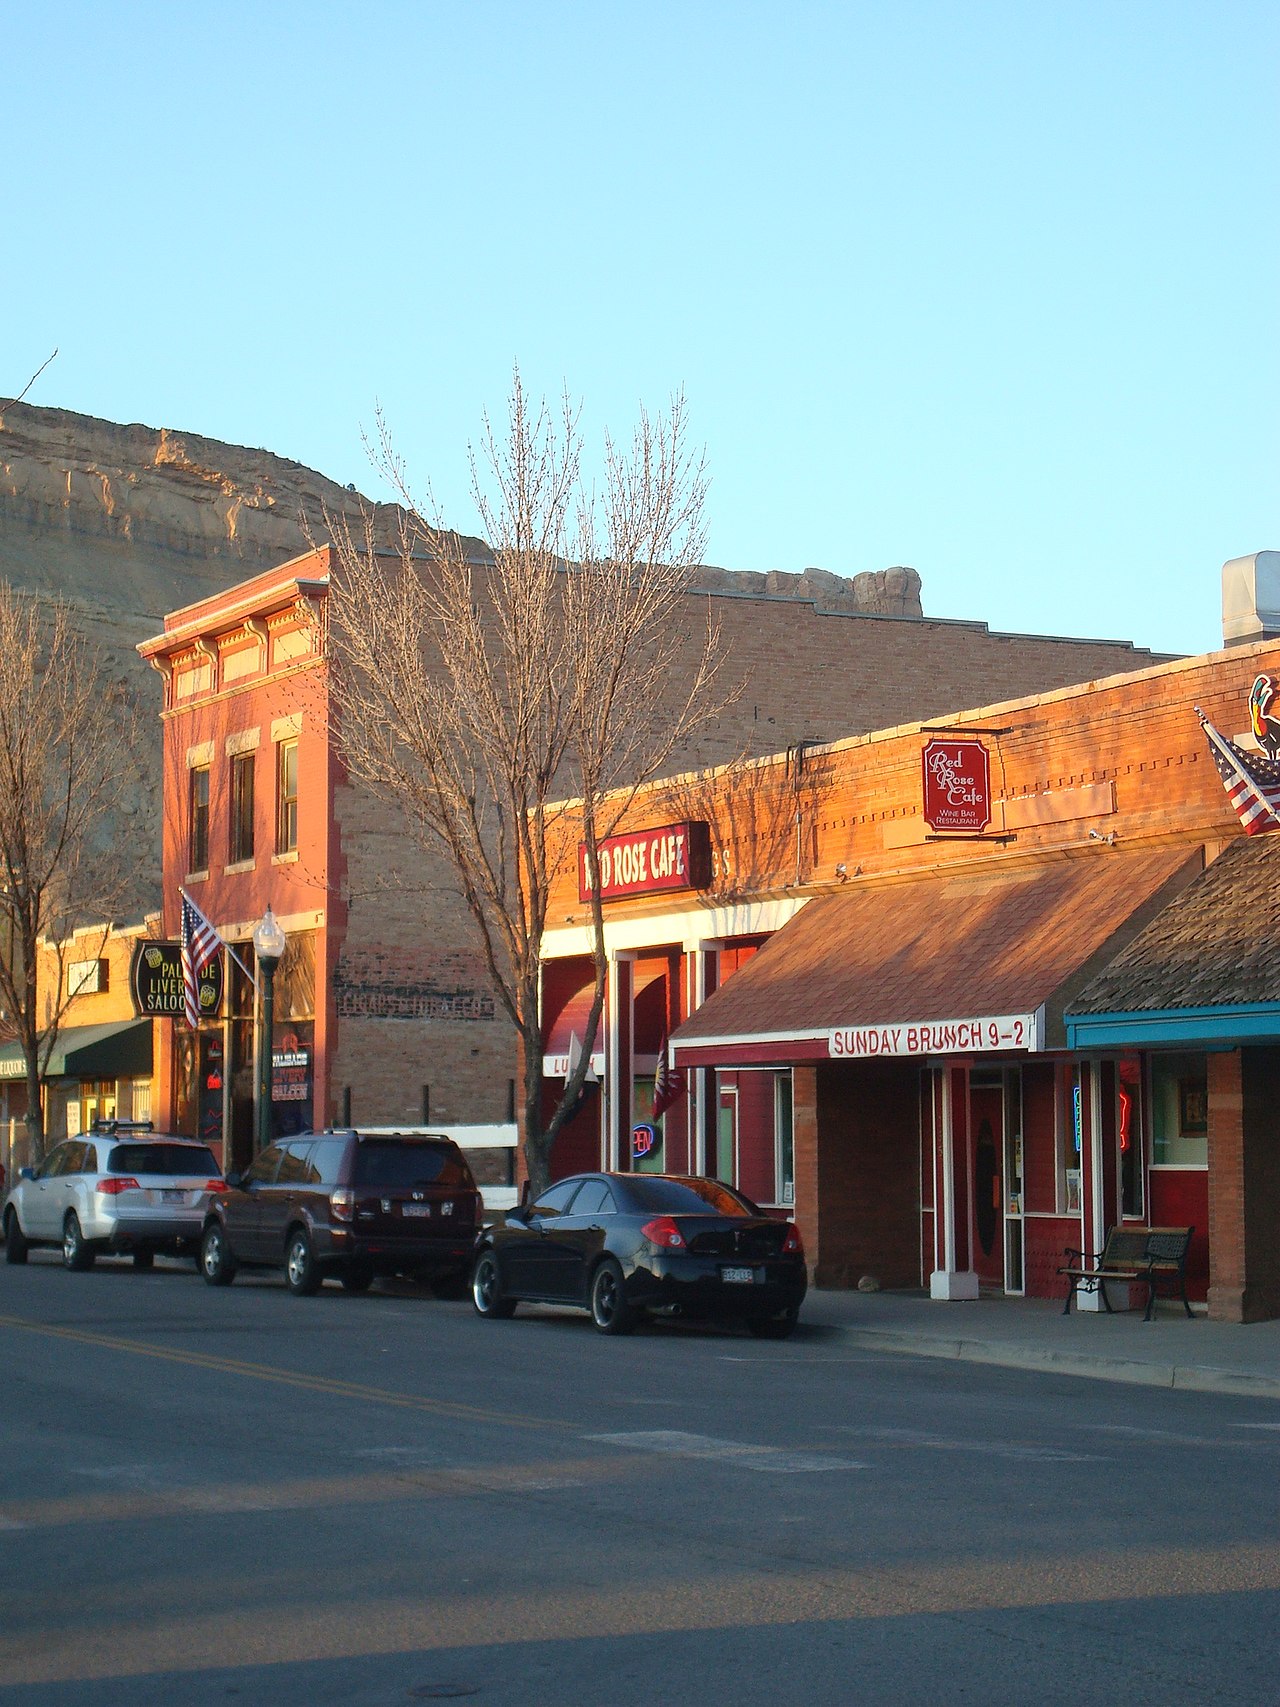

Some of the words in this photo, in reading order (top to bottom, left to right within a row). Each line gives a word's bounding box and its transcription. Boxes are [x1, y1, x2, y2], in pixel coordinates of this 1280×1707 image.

[929, 751, 963, 773] Red
[936, 768, 974, 790] Rose
[947, 787, 983, 806] Cafe
[584, 850, 611, 891] RD
[613, 842, 647, 887] ROSE
[650, 835, 685, 879] CAFE
[150, 979, 185, 994] LIVER
[147, 995, 187, 1010] SALOO
[834, 1029, 901, 1055] SUNDAY
[906, 1022, 983, 1052] BRUNCH
